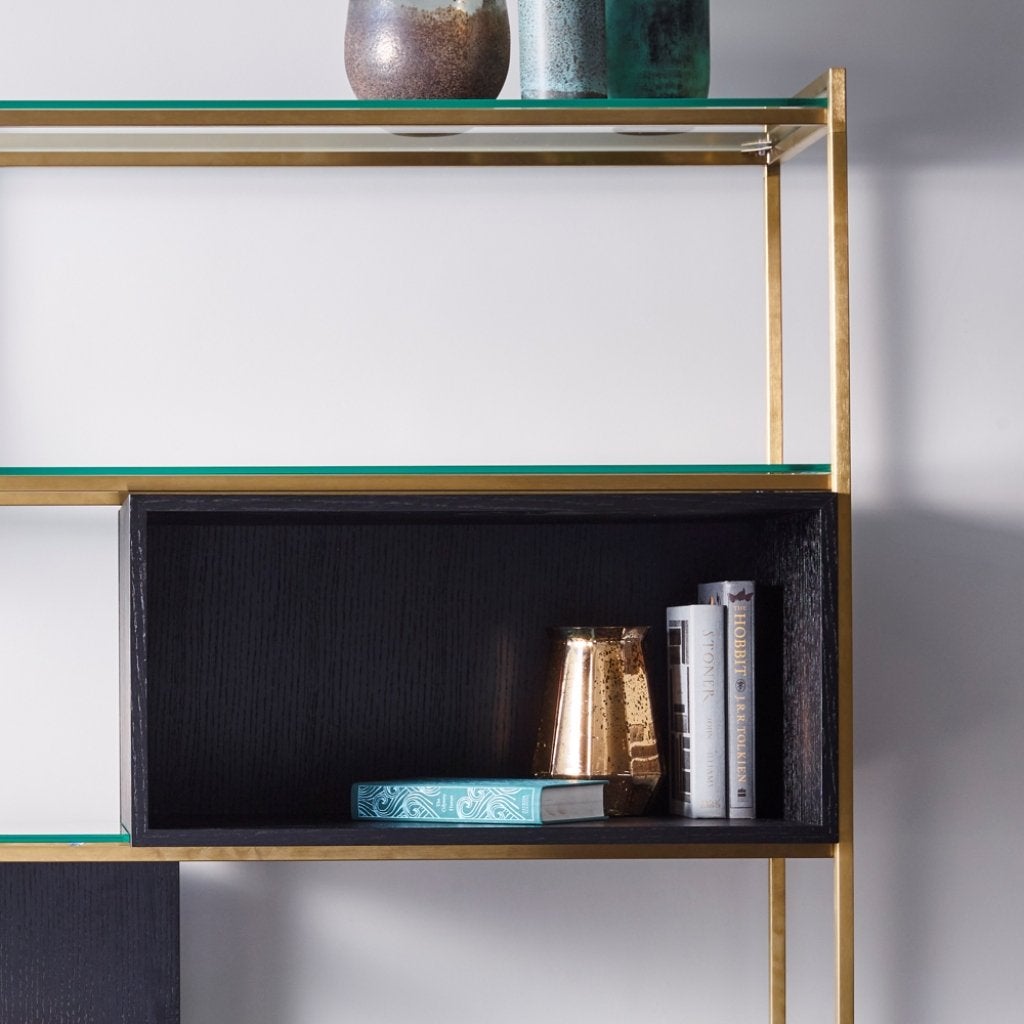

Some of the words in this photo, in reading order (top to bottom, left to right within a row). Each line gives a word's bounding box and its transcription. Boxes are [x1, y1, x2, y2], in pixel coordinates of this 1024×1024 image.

[702, 629, 715, 703] STONER
[734, 612, 747, 677] HOBBIT
[735, 726, 747, 783] TOLKIEN
